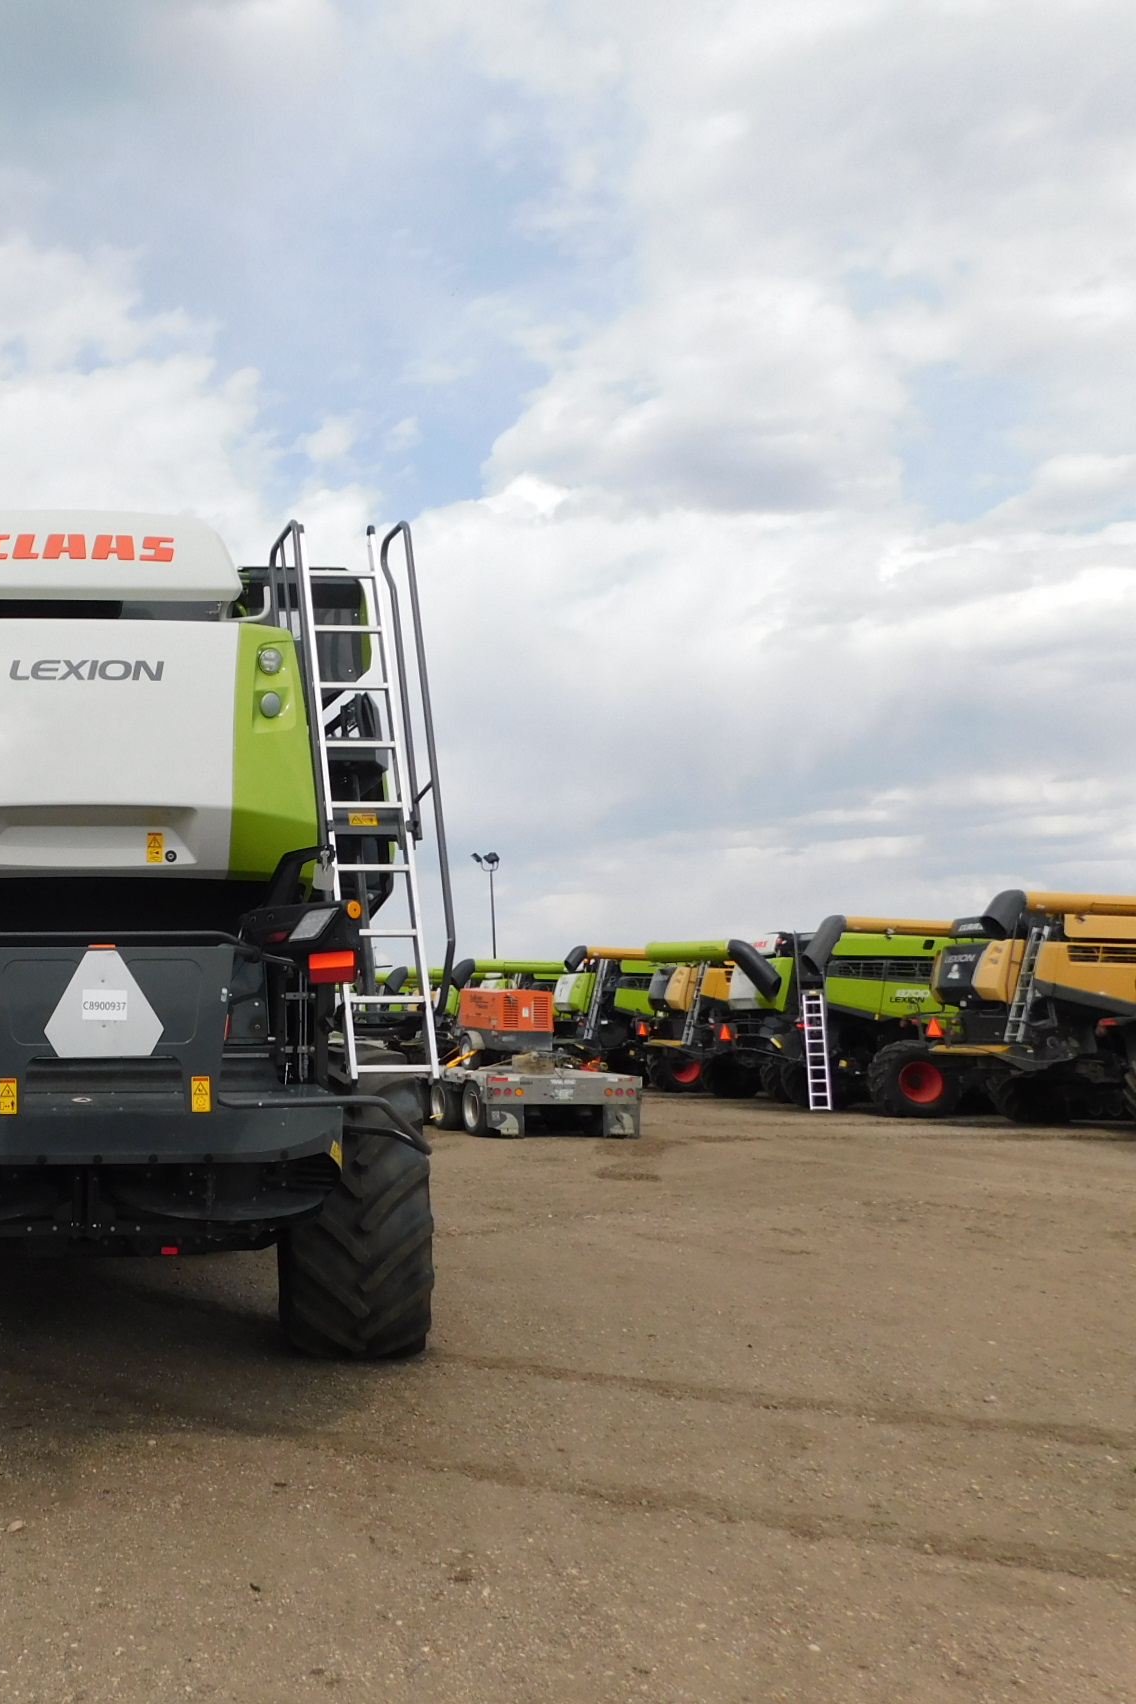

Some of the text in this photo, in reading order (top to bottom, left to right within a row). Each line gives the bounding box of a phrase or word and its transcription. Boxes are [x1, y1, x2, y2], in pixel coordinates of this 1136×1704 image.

[9, 659, 165, 682] LEXION
[944, 953, 976, 964] LEXION
[82, 1000, 127, 1011] C8900937
[889, 996, 925, 1004] LEXION
